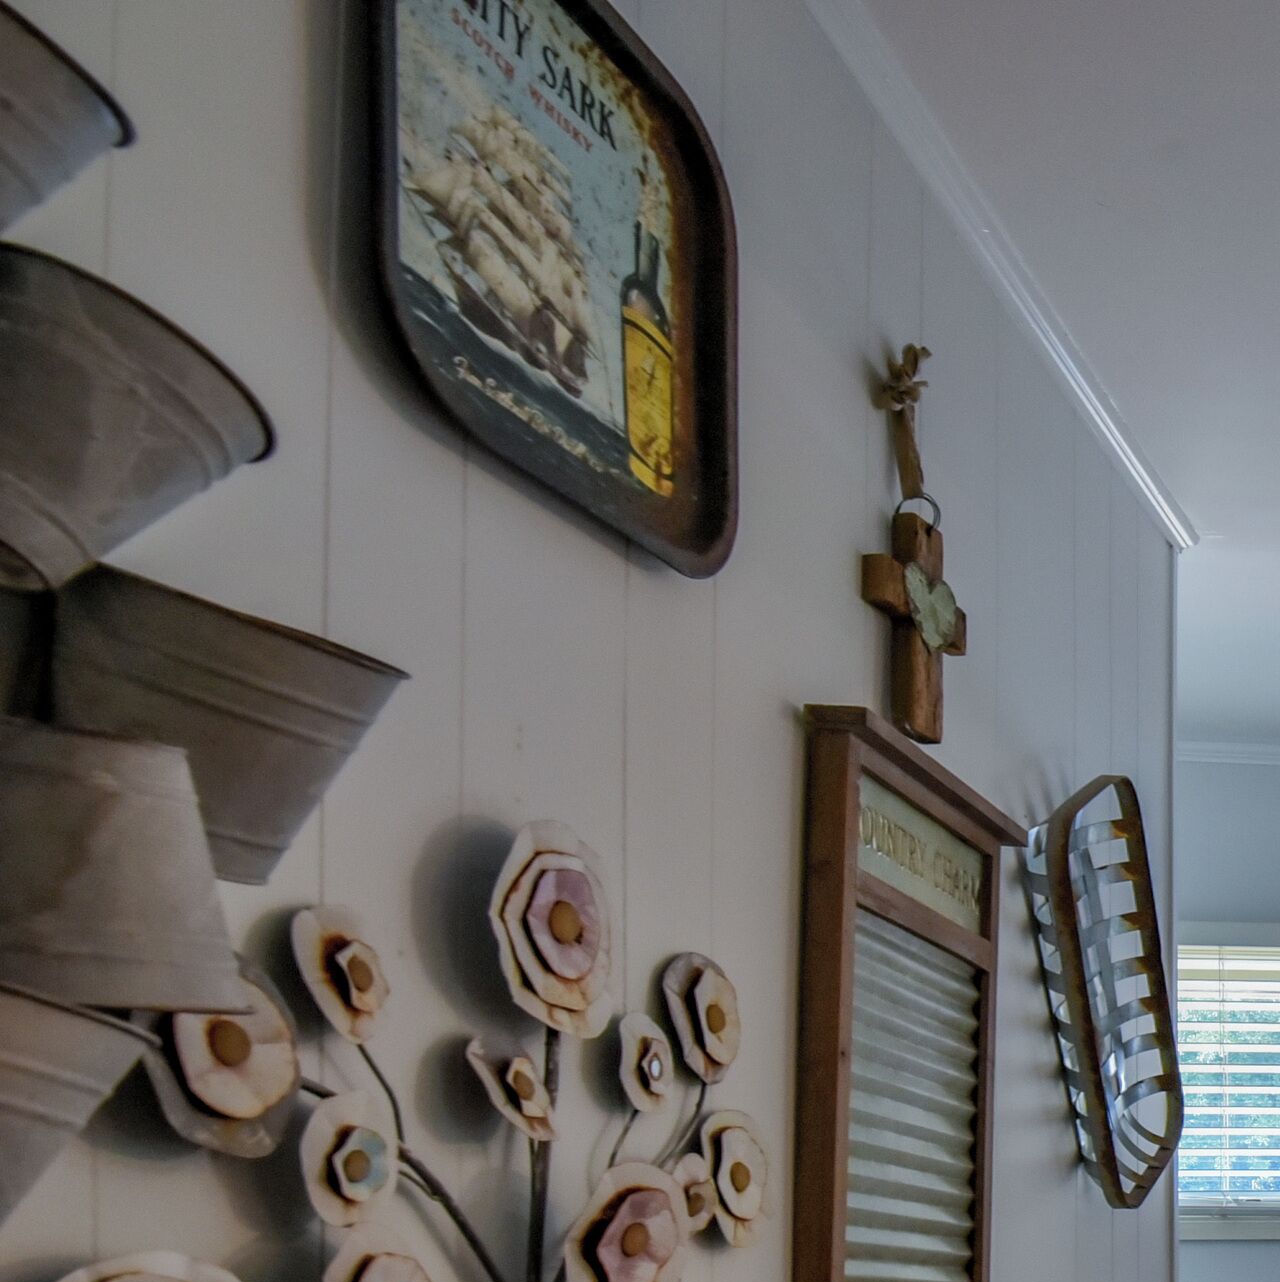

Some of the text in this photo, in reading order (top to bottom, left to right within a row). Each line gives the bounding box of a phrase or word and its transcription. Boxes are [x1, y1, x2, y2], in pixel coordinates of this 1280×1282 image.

[452, 8, 593, 152] SCOTCH WHISKY
[538, 45, 617, 151] SARK
[860, 806, 927, 881] OUNTRY
